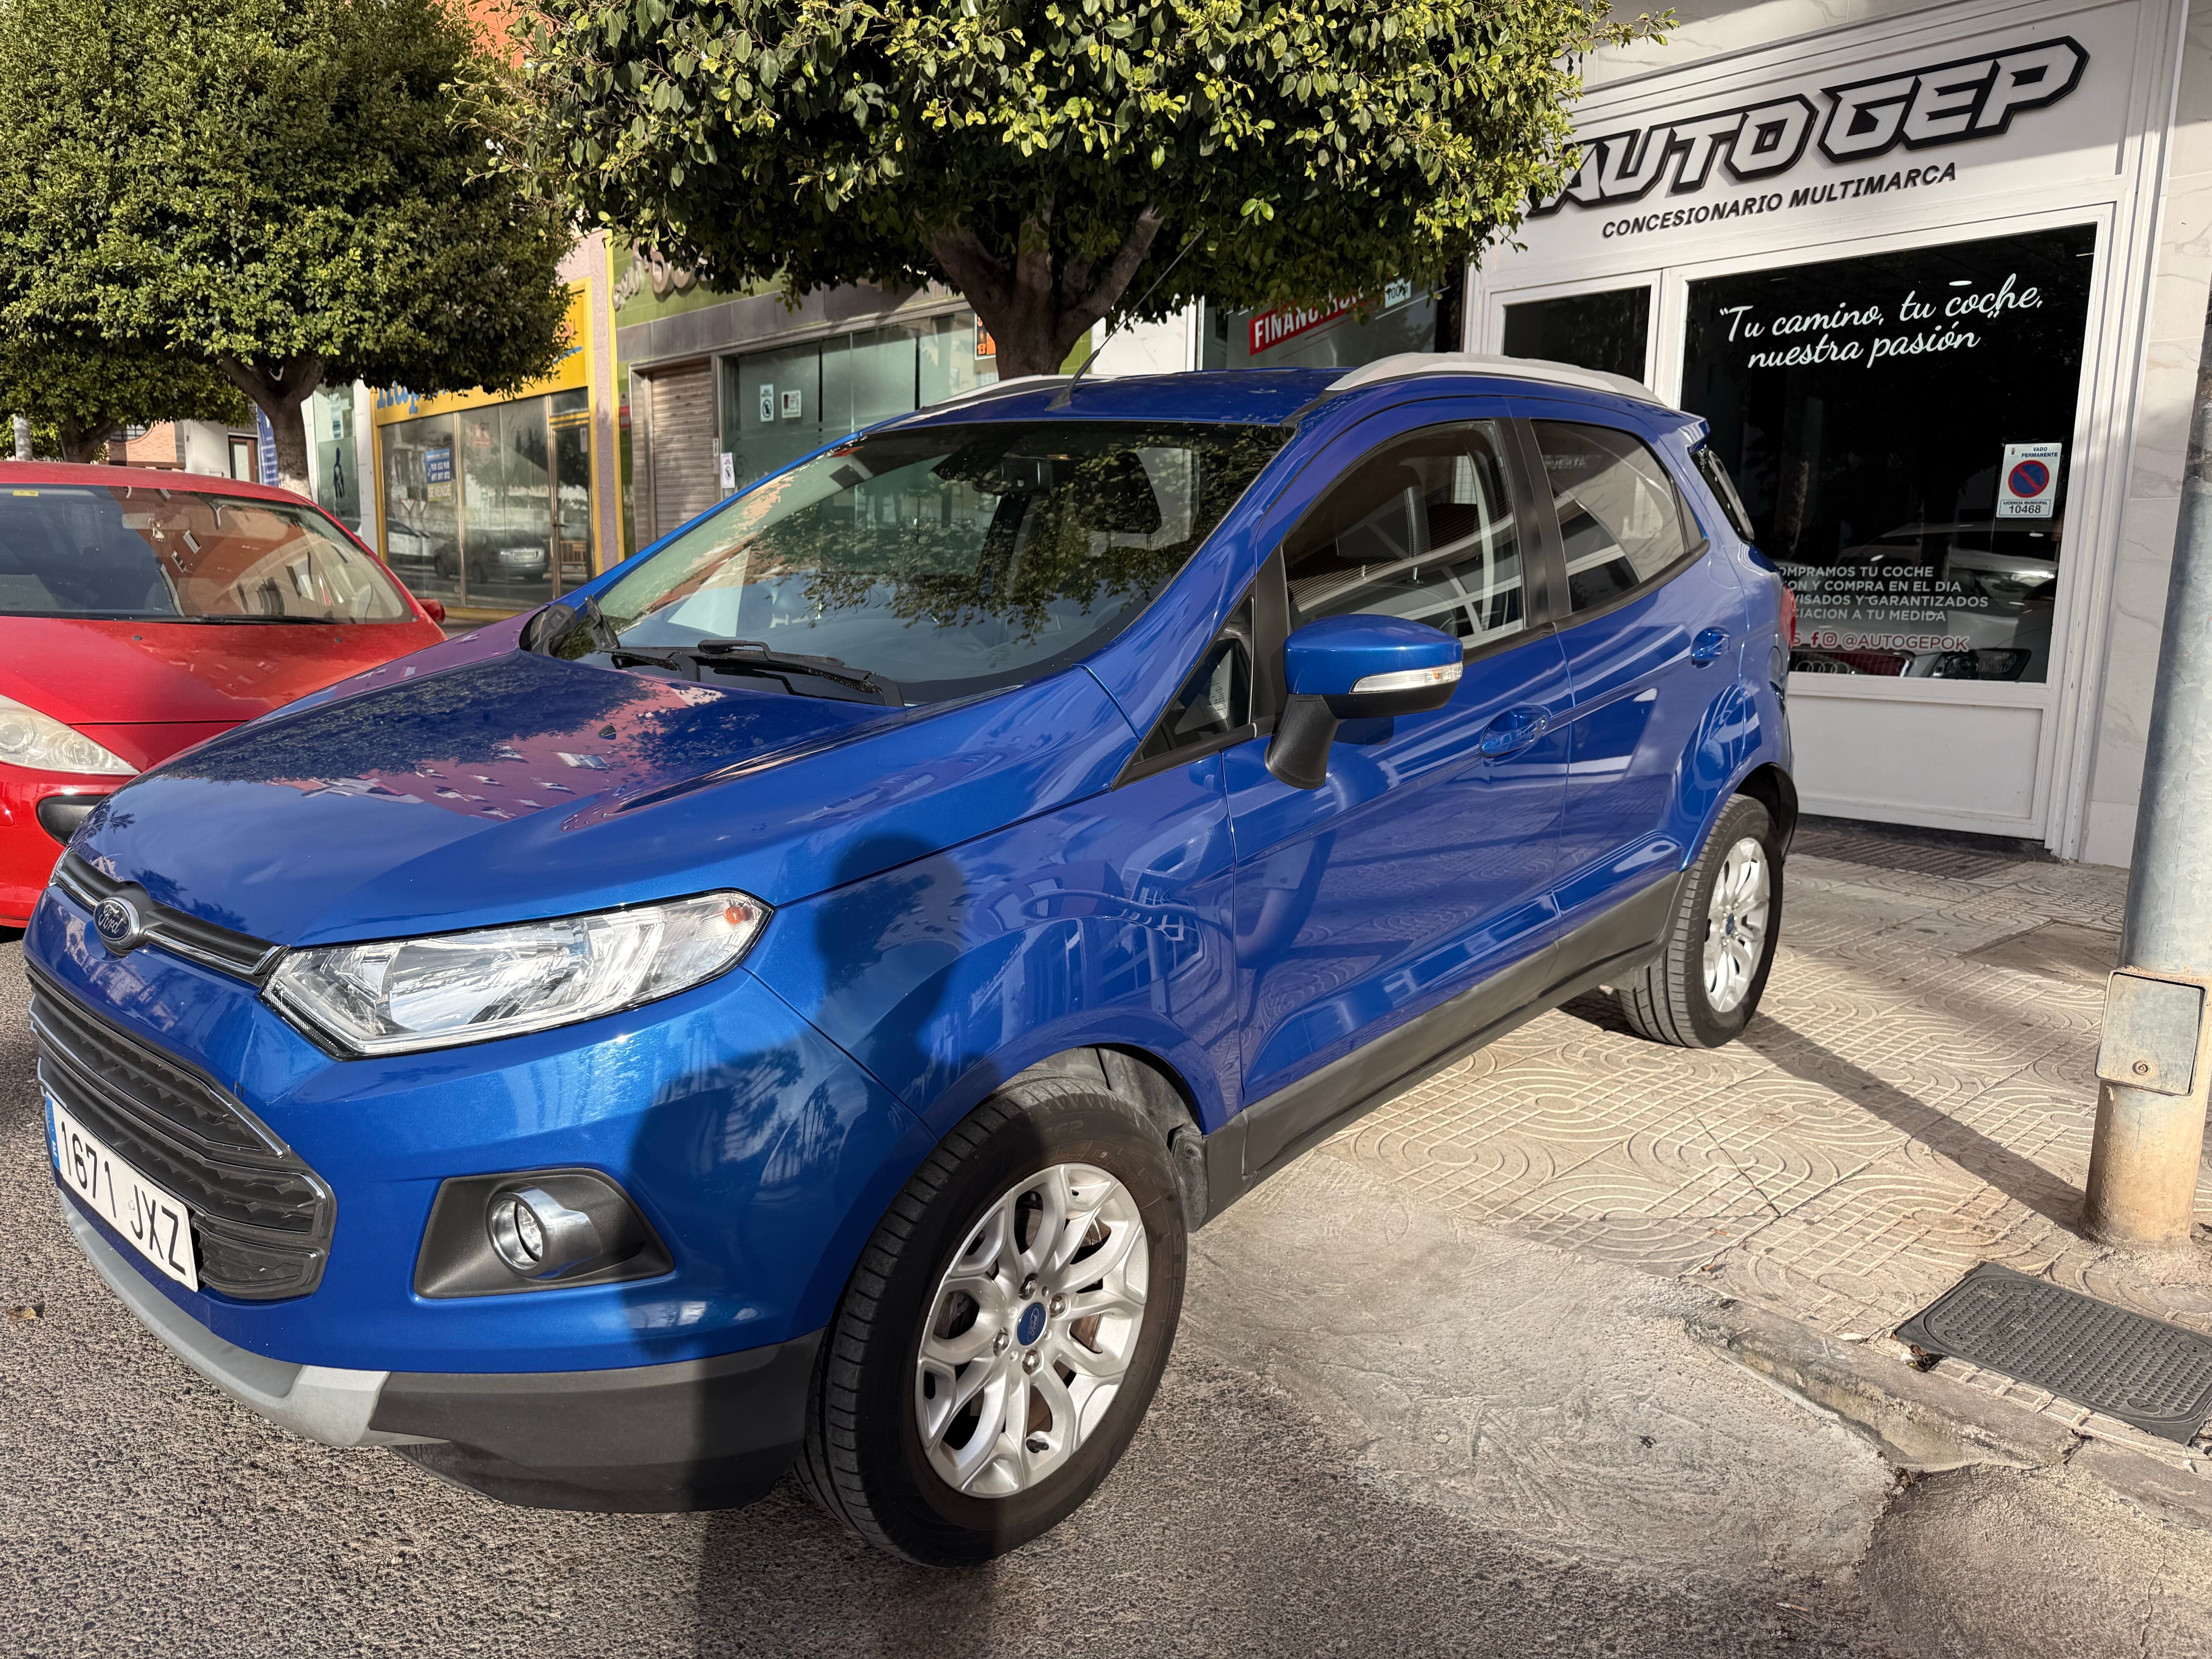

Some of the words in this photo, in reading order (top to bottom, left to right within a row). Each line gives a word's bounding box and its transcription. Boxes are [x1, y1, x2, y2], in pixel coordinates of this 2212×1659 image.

[1817, 35, 2090, 163] GEP
[1602, 193, 1782, 238] CONCESIONARIO
[1788, 162, 1956, 208] MULTIMARCA
[1772, 302, 1884, 336] camino,
[1899, 290, 1936, 321] tu
[1945, 273, 2043, 317] coche,
[1747, 333, 1864, 368] nuestra
[2009, 505, 2041, 514] 10468
[1779, 566, 1856, 577] OMPRAMOS
[1860, 566, 1878, 577] TU
[1882, 566, 1934, 577] COCHE
[1812, 580, 1820, 591] Y
[1824, 580, 1884, 592] COMPRA
[1889, 581, 1908, 592] EN
[1913, 581, 1930, 592] EL
[1935, 581, 1961, 592] DIA
[1795, 594, 1851, 605] ISADOS
[1855, 595, 1865, 606] Y
[1868, 595, 1989, 608] GARANTIZADOS
[1796, 608, 1848, 619] IACION
[1851, 609, 1862, 620] A
[1866, 609, 1885, 620] TU
[1889, 610, 1946, 622] MEDIDA
[1842, 633, 1969, 651] @AUTOGEPOK
[98, 904, 123, 934] Ford
[61, 1121, 117, 1219] 1671
[130, 1184, 186, 1277] JXZ
[1029, 1314, 1038, 1336] Ford
